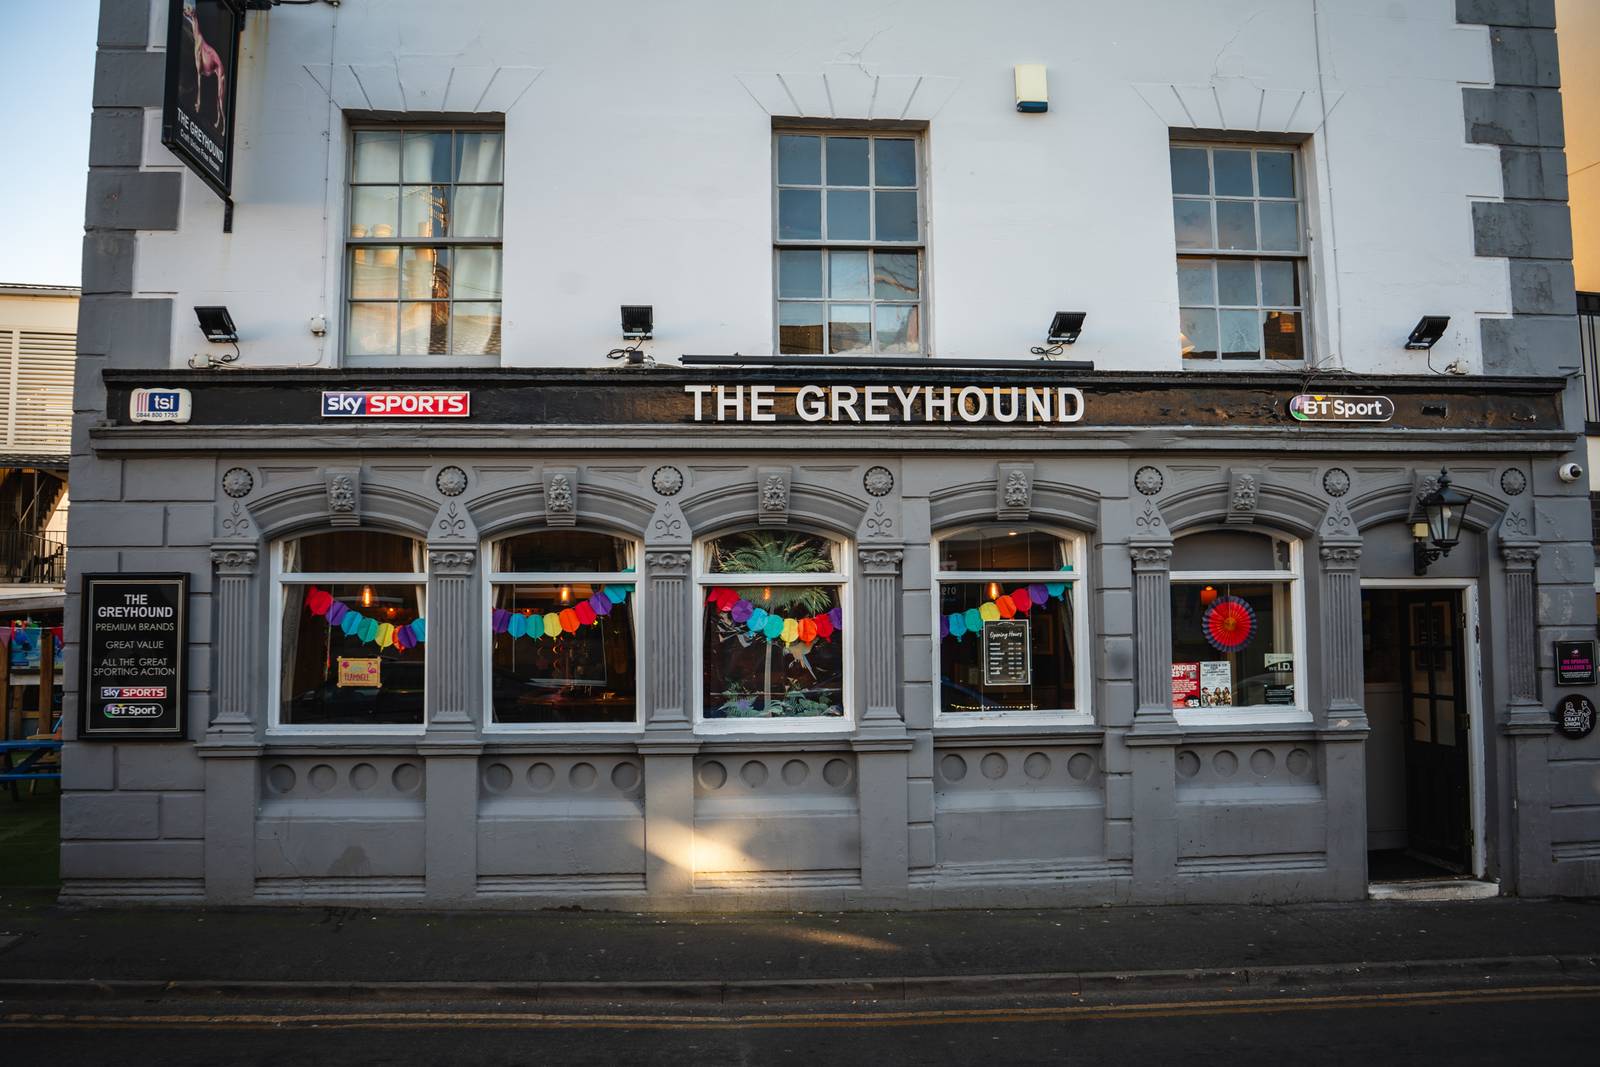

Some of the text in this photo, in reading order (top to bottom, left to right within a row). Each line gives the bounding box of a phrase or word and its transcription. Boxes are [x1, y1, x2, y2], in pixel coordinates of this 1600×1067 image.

[177, 107, 224, 163] THE GREYHOUND
[154, 395, 174, 410] tsi
[327, 393, 464, 415] sky SPORTS
[684, 384, 1086, 423] THE GREYHOUND
[1303, 400, 1383, 418] BT Sport
[124, 594, 148, 605] THE
[98, 606, 173, 617] GREYHOUND
[95, 622, 175, 631] PREMIUM BRANDS
[990, 630, 1022, 640] Opening Hours
[105, 640, 164, 649] GREAT VALUE
[101, 657, 168, 667] ALL THE GREAT
[93, 667, 175, 676] SPORTING ACTION
[103, 688, 164, 698] sky SPORTS
[111, 705, 157, 716] BT Sport
